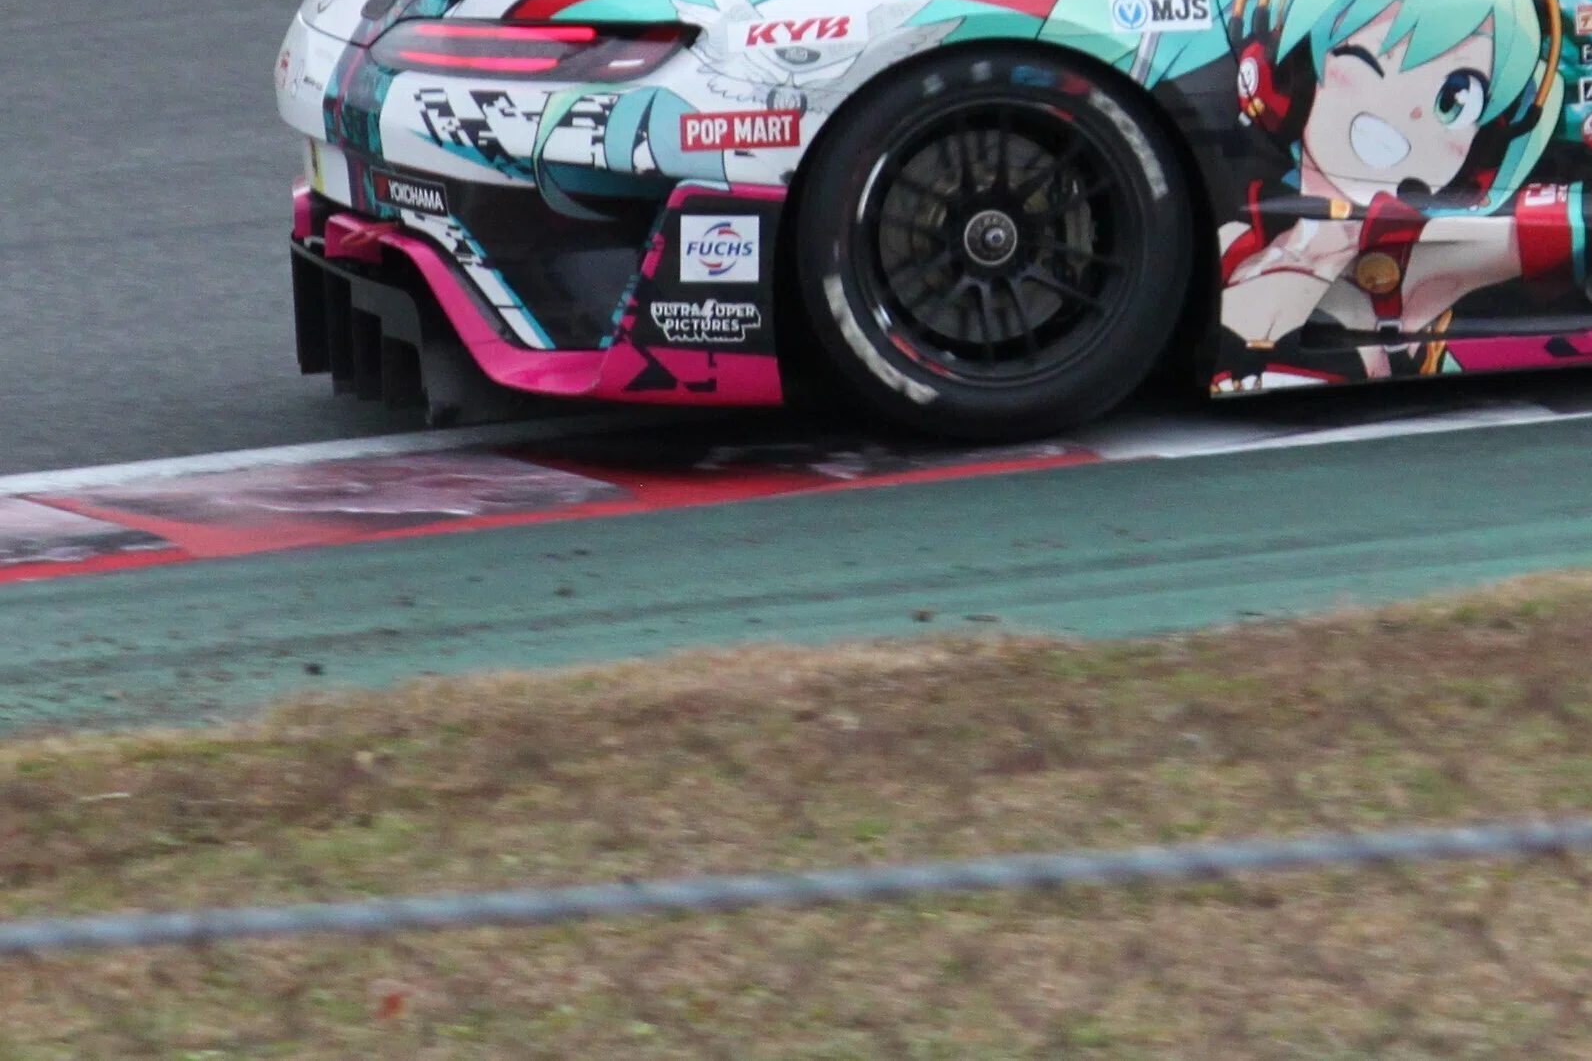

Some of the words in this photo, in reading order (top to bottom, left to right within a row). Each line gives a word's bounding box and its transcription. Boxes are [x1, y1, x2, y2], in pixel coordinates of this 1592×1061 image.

[745, 15, 850, 47] KYB
[686, 117, 728, 146] POP
[734, 114, 793, 144] MART
[388, 180, 444, 212] YOKOHAMA
[686, 241, 753, 256] FUCHS
[652, 302, 699, 318] ULTRA
[665, 318, 740, 331] PICTURES
